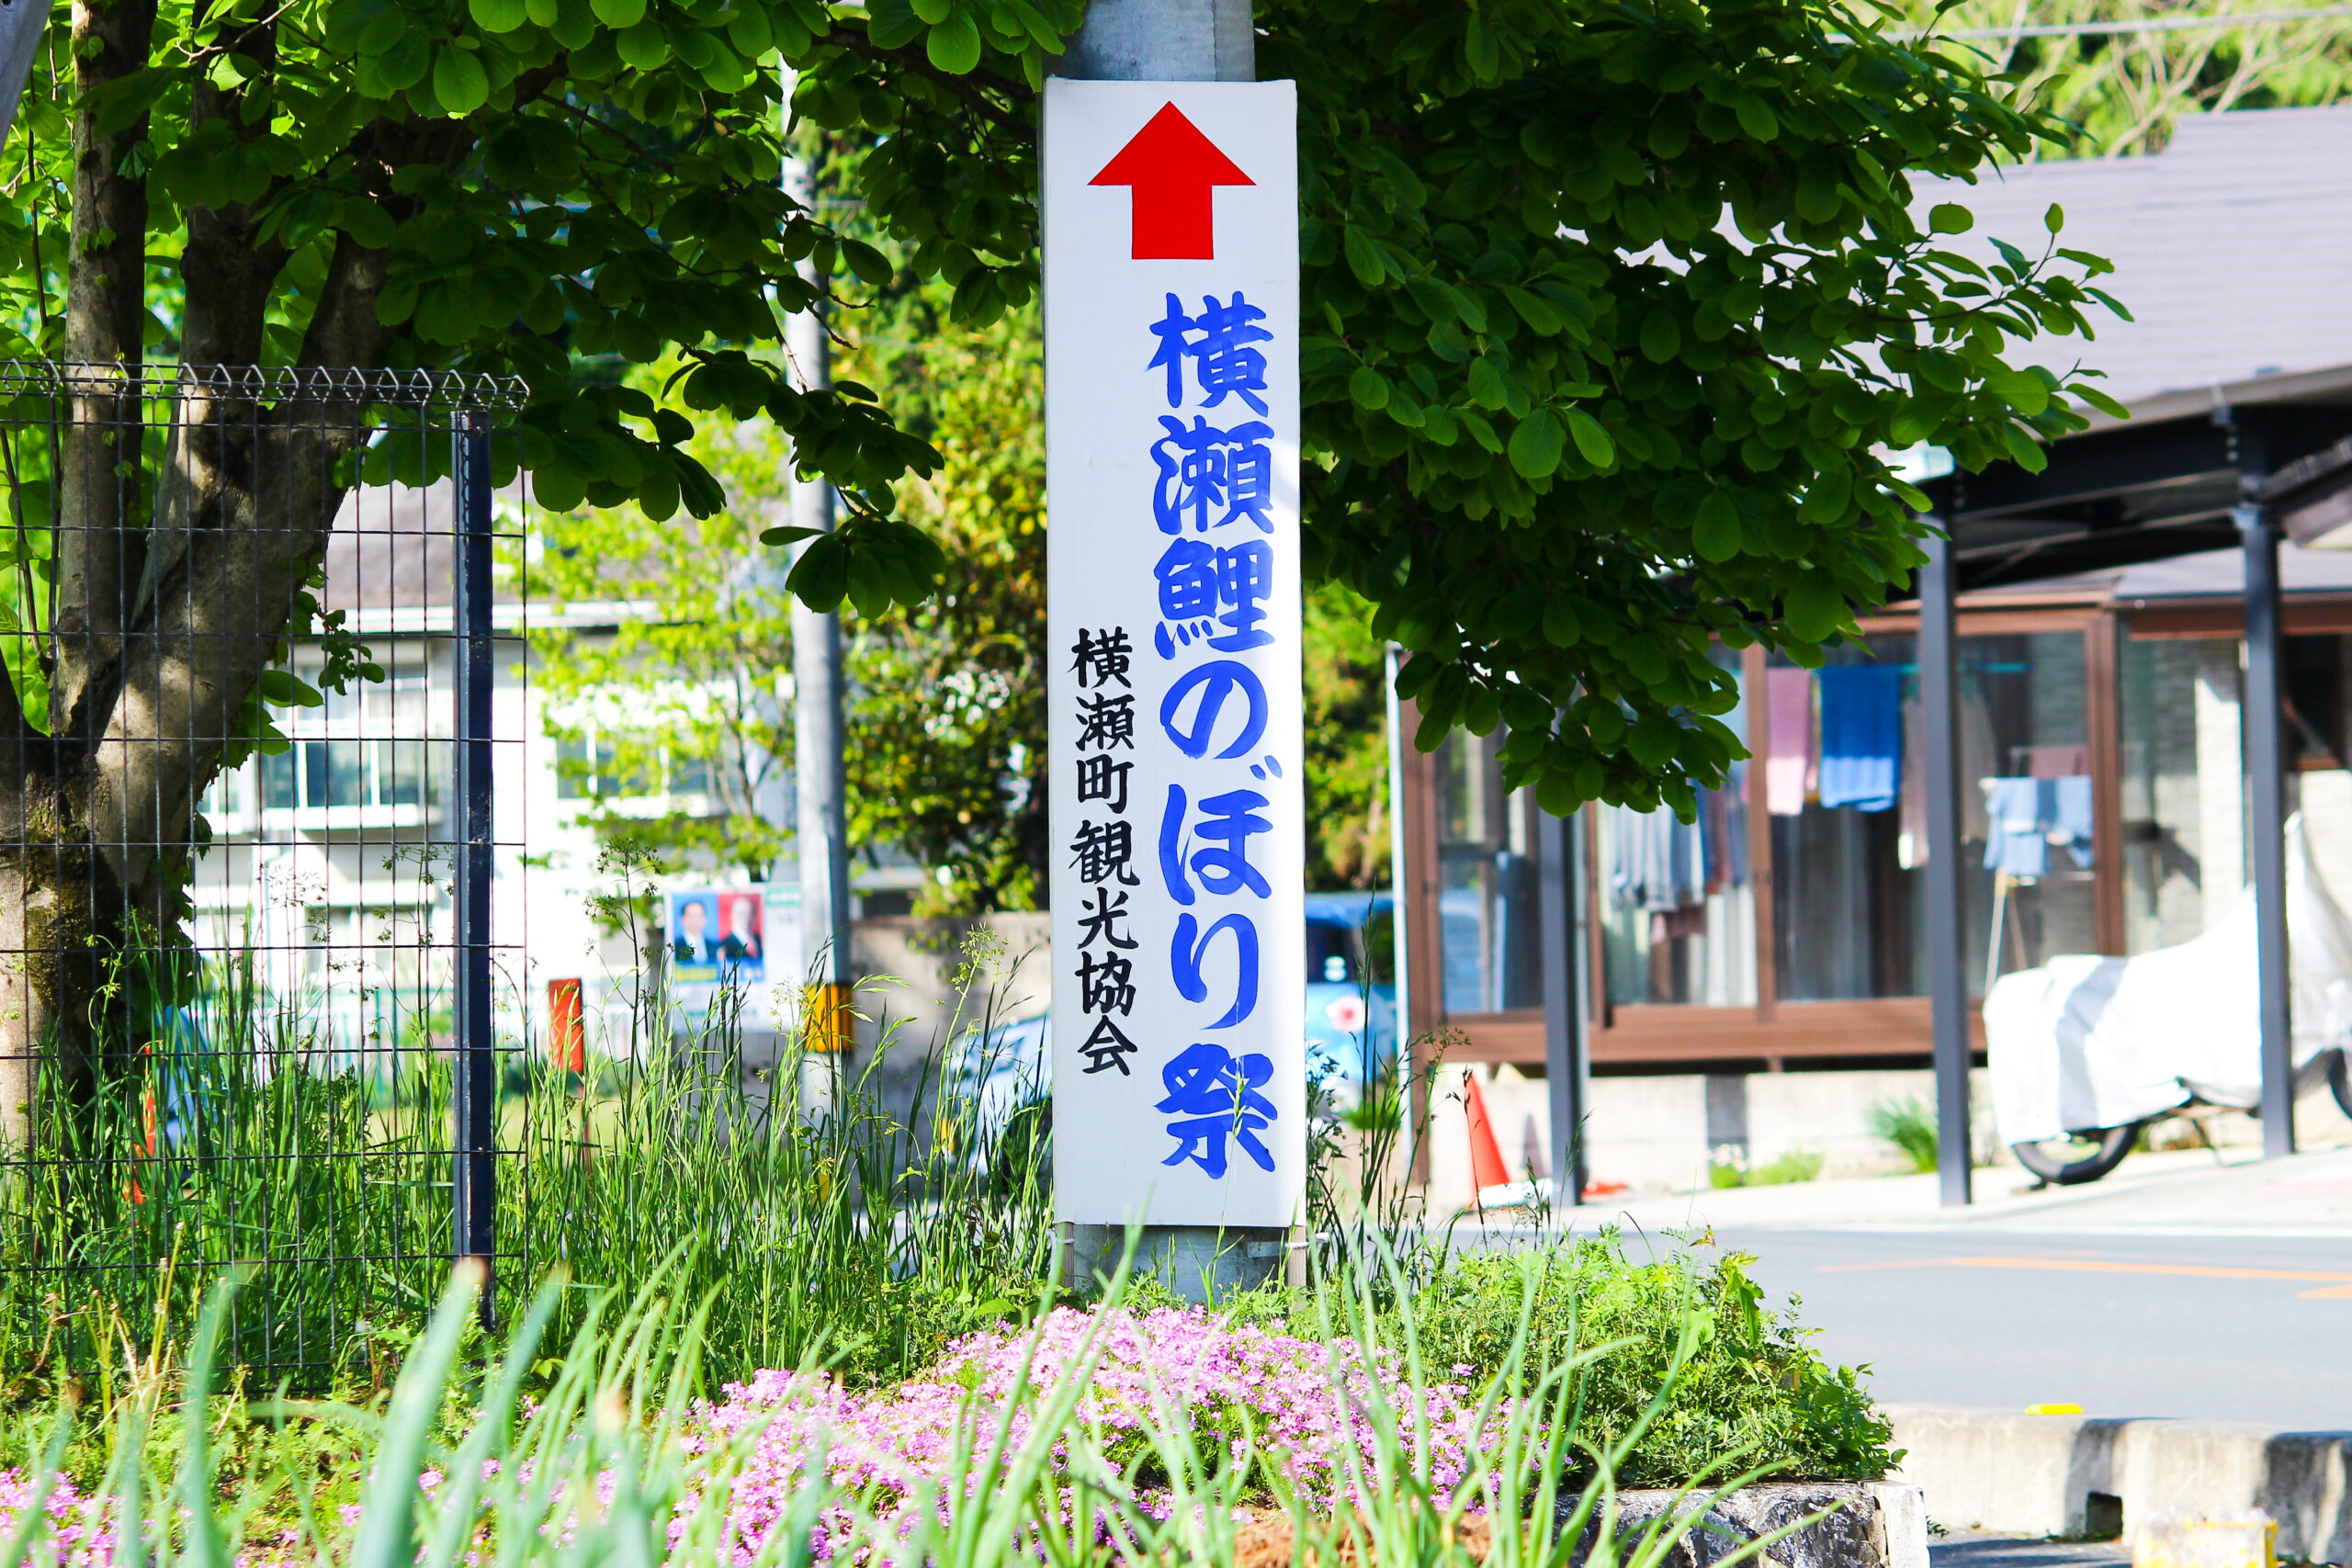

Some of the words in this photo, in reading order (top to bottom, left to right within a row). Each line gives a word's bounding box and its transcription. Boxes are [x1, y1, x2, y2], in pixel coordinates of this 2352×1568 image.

[1067, 626, 1141, 1077] 横瀬町観光協会
[1146, 290, 1283, 1179] 横瀬鯉のぼり祭
